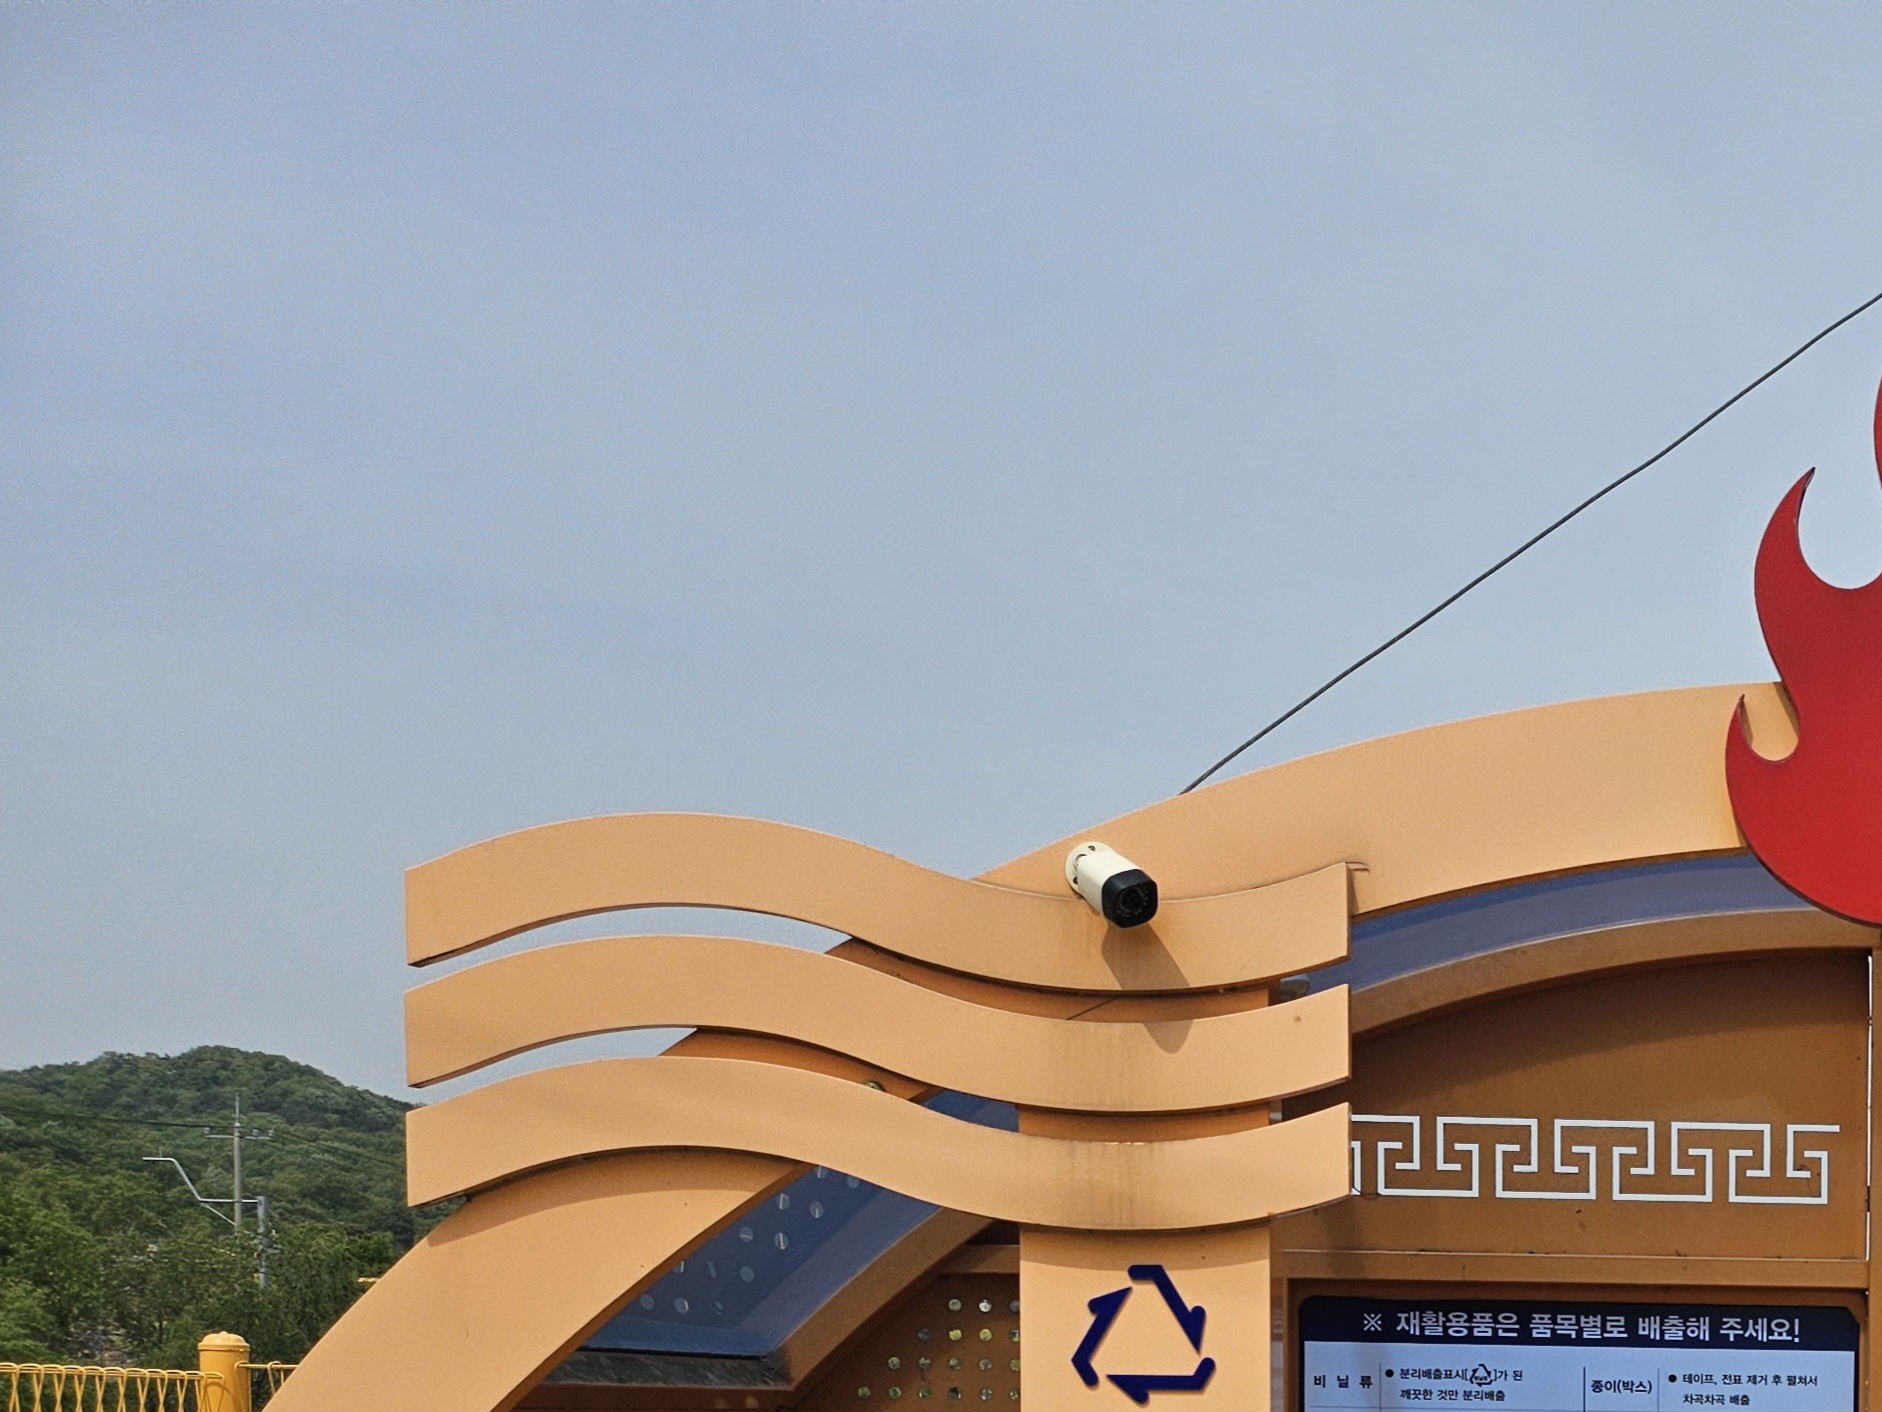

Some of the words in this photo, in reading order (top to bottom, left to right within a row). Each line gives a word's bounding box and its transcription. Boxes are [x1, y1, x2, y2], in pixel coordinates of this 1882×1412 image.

[1396, 1311, 1520, 1337] 재활용품은
[1530, 1314, 1628, 1338] 품목별로
[1638, 1316, 1709, 1341] 배출해
[1720, 1318, 1799, 1342] 주세요!
[1722, 1374, 1742, 1385] 전표
[1746, 1375, 1767, 1385] 제거
[1772, 1375, 1782, 1385] 후
[1787, 1376, 1817, 1386] 펼쳐서
[1591, 1380, 1652, 1394] 종이(박스)
[1400, 1389, 1433, 1400] 깨끗한
[1437, 1390, 1458, 1400] 것만
[1463, 1390, 1505, 1401] 분리배출
[1683, 1394, 1725, 1405] 차곡차곡
[1730, 1395, 1750, 1405] 배출
